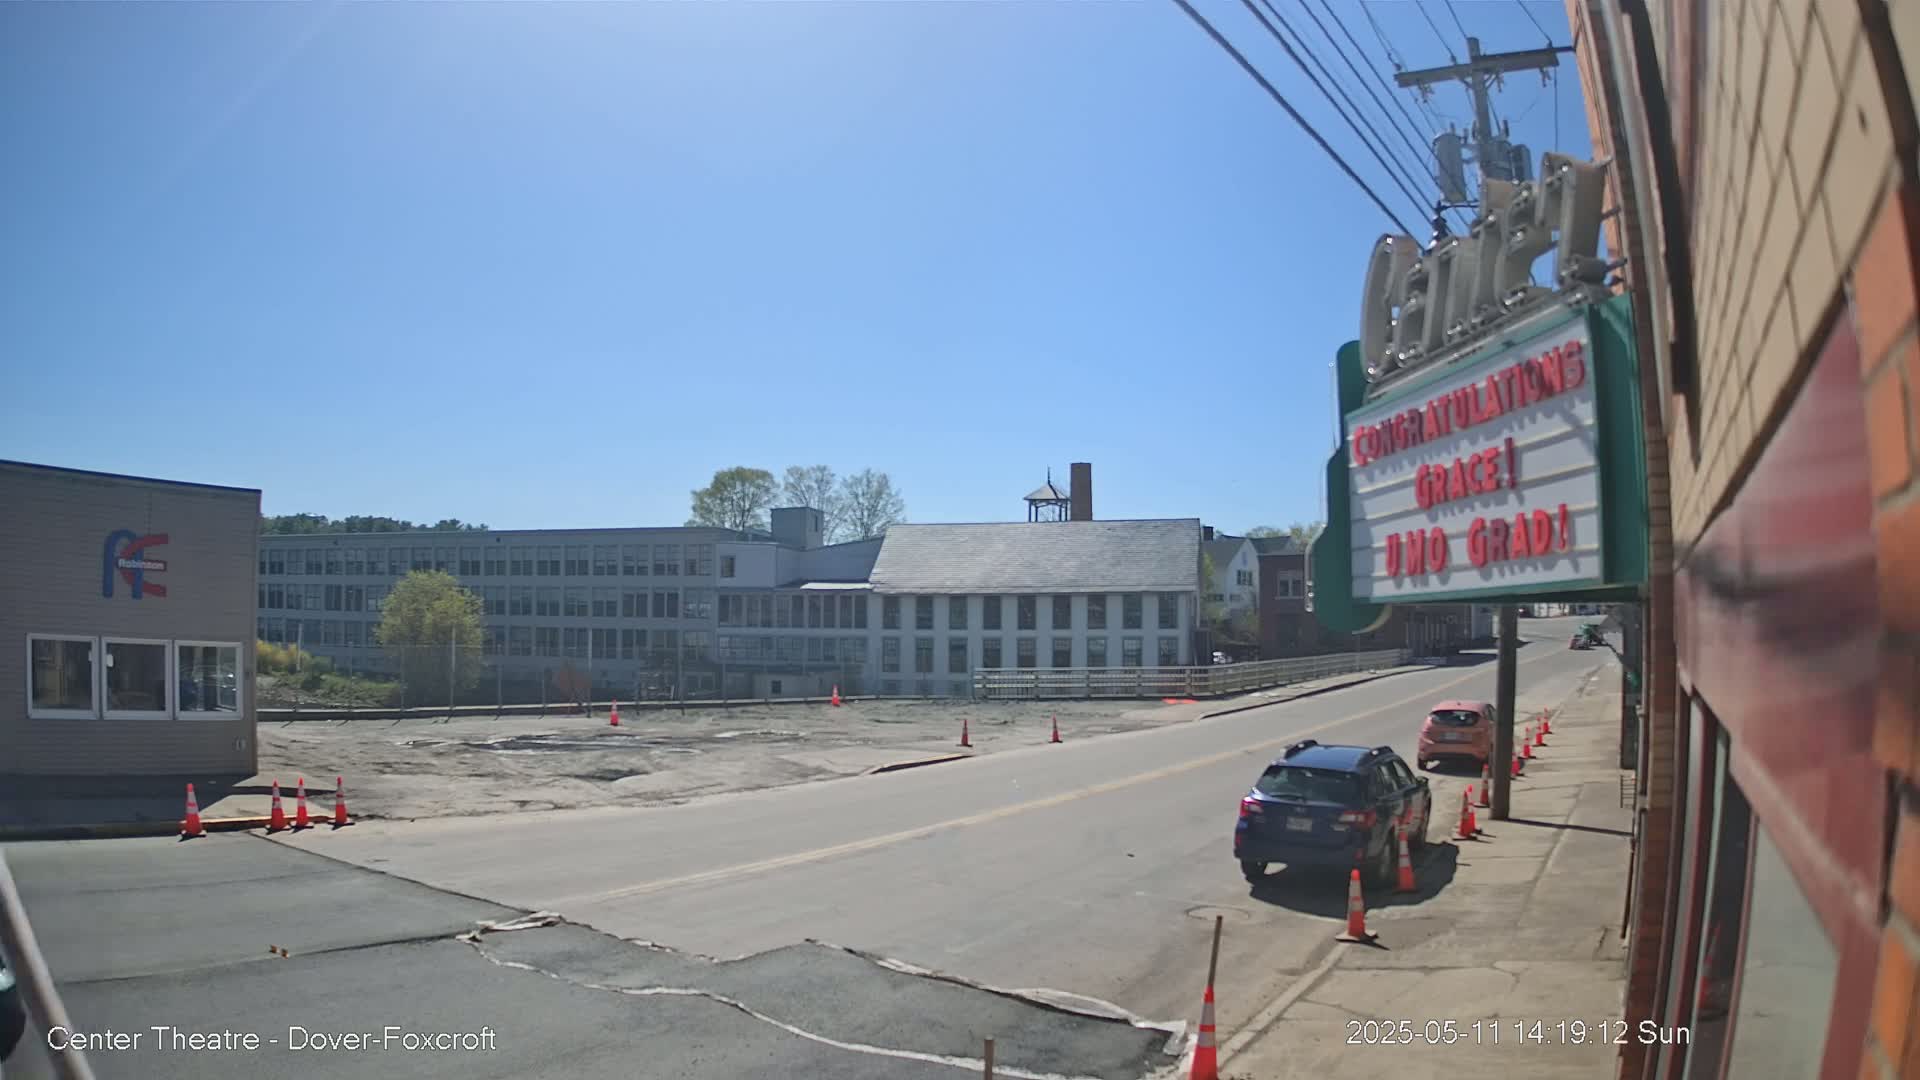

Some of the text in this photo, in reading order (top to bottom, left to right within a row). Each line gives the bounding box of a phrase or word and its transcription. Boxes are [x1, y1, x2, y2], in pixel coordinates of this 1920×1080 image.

[1353, 341, 1585, 467] CONGRATULATIONS
[1415, 437, 1516, 510] GRACE!
[1385, 503, 1568, 577] UMO GRAD!
